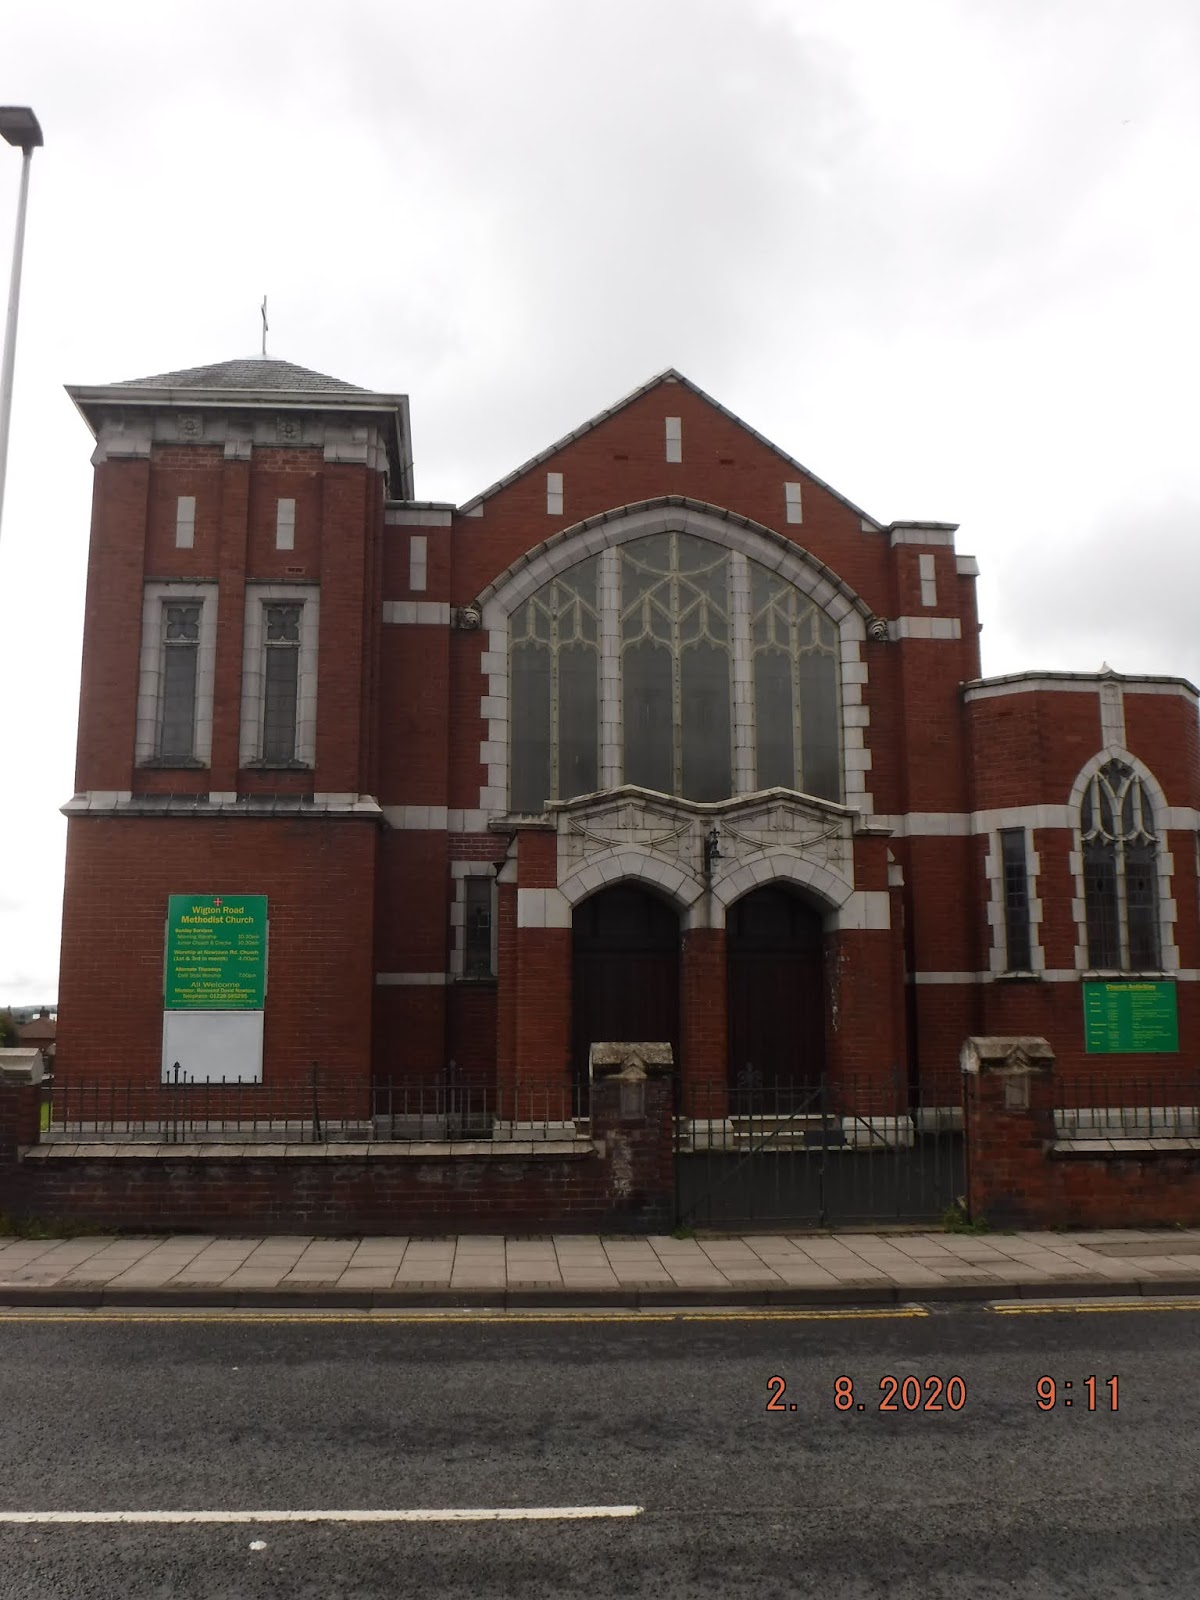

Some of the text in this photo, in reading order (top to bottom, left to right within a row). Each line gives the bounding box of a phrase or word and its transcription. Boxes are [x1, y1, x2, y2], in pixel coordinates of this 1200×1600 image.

[192, 906, 245, 915] Wigton Road
[181, 916, 254, 924] Methodist Church
